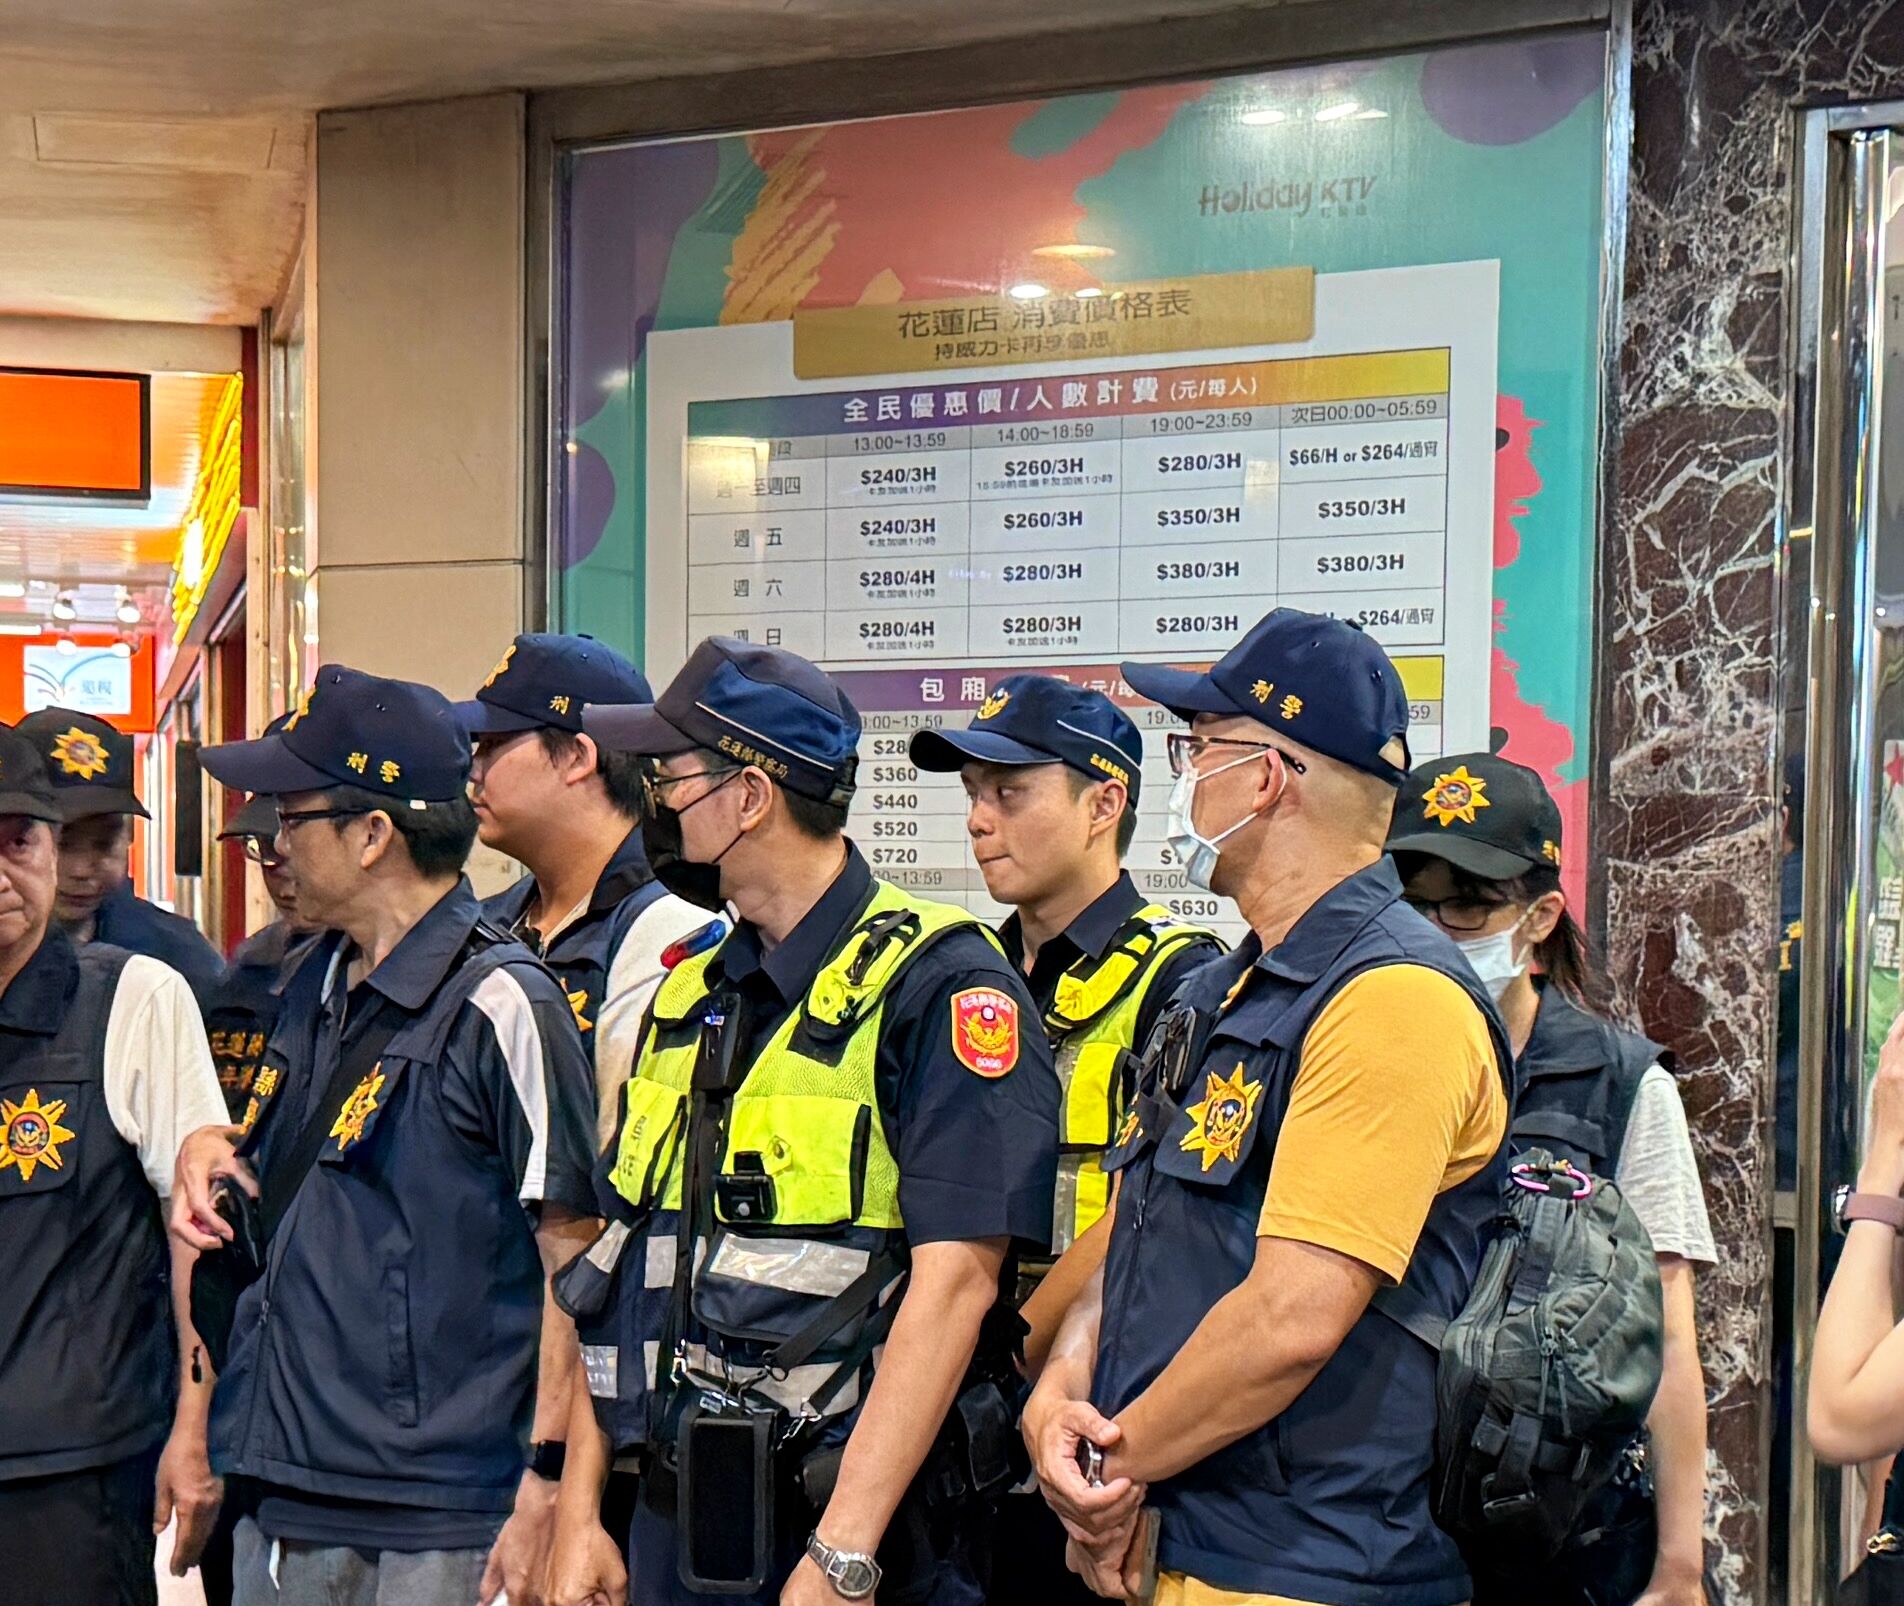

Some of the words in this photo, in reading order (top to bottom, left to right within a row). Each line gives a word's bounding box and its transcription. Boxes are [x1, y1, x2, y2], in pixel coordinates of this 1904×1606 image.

[1198, 181, 1313, 218] Holiday
[1320, 175, 1378, 203] KTV
[898, 306, 999, 340] 花蓮店
[1012, 288, 1193, 331] 消費價格表
[843, 376, 1160, 423] 全民優惠價/人數計費
[1170, 376, 1258, 402] (元/每人)
[1150, 411, 1253, 434] 19:00~23:59
[1291, 399, 1438, 425] 次日00:00~05:59
[853, 432, 947, 453] 13:00~13:59
[996, 422, 1094, 444] 14:00~18:59
[1004, 457, 1085, 478] $260/3H
[1157, 452, 1243, 474] $280/3H
[1288, 447, 1338, 467] $66/H
[1343, 452, 1358, 463] or
[860, 466, 937, 486] $240/3H
[1156, 507, 1241, 528] $350/3H
[1317, 497, 1406, 519] $350/3H
[860, 517, 937, 538] $240/3H
[1003, 510, 1084, 531] $260/3H
[1002, 562, 1083, 583] $280/3H
[1156, 561, 1240, 582] $380/3H
[1316, 554, 1405, 574] $380/3H
[733, 579, 784, 598] 週六
[859, 569, 936, 588] $280/4H
[859, 620, 935, 639] $280/4H
[1002, 615, 1082, 634] $280/3H
[1156, 615, 1239, 634] $280/3H
[872, 767, 919, 783] $360
[872, 793, 919, 810] $440
[872, 820, 919, 837] $520
[872, 848, 919, 864] $720
[1168, 898, 1219, 917] $630
